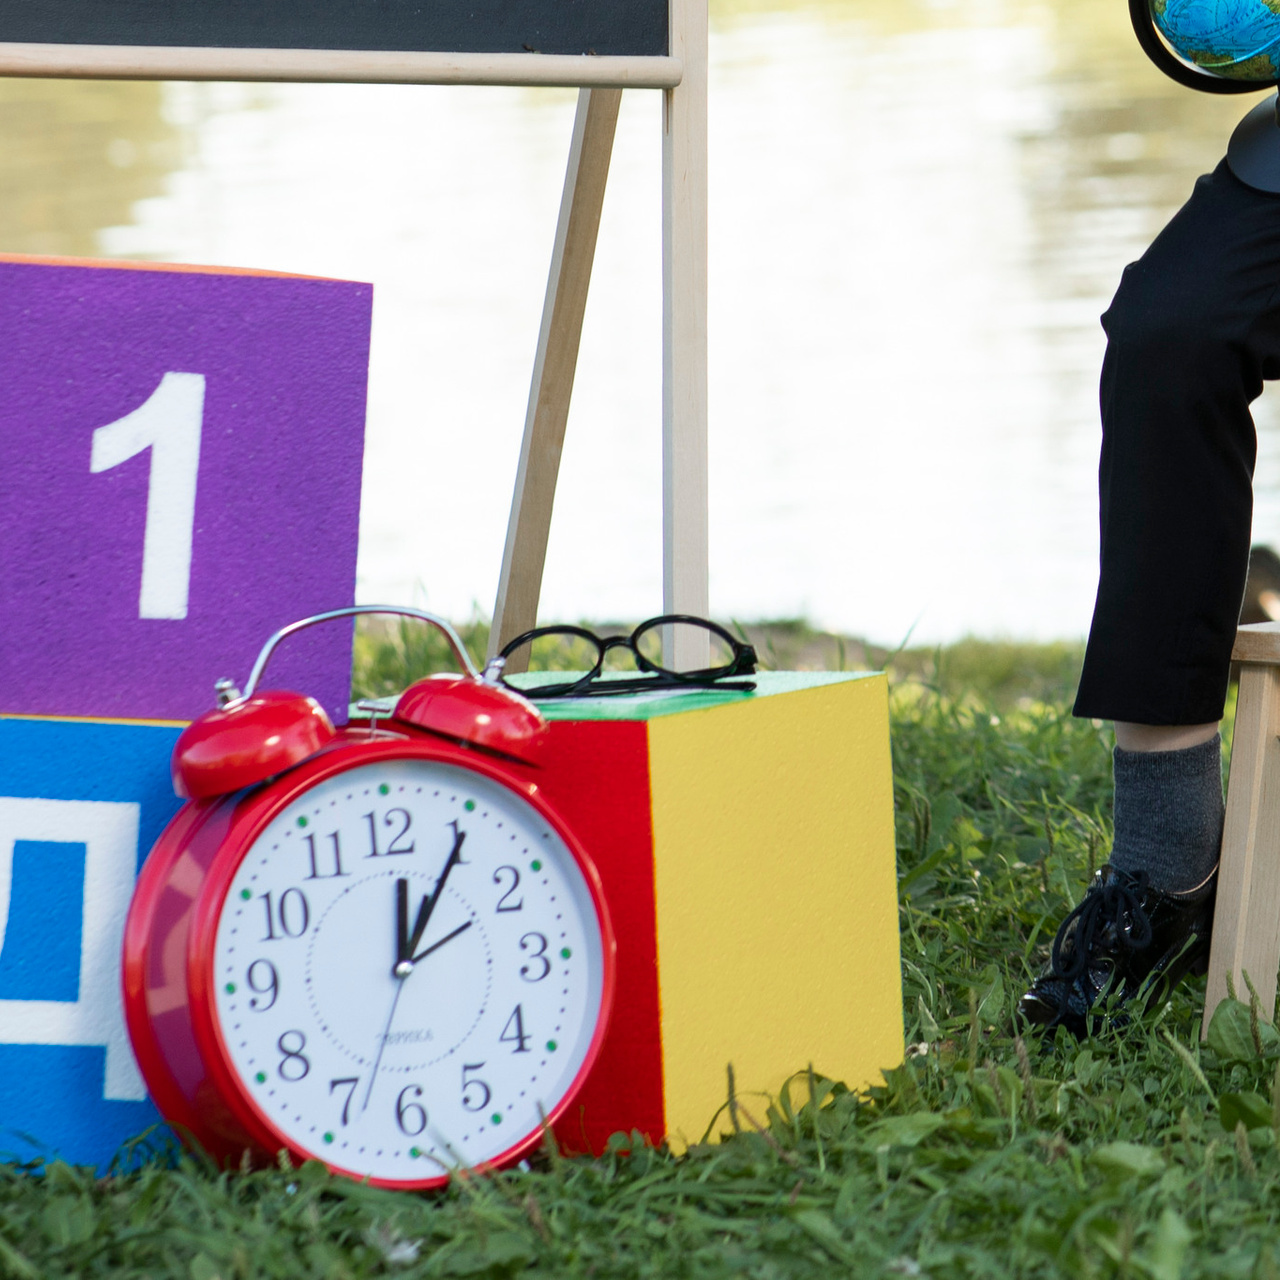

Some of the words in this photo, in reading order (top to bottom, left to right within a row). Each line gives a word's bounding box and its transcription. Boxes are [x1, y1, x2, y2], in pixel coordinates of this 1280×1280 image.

[90, 371, 205, 620] 1
[301, 829, 352, 881] 11
[361, 808, 415, 859] 12
[258, 887, 310, 942] 10
[493, 865, 524, 914] 2
[519, 931, 552, 983] 3
[246, 958, 280, 1013] 9
[499, 1003, 532, 1054] 4
[277, 1029, 311, 1082] 8
[329, 1077, 359, 1126] 7
[395, 1083, 428, 1136] 6
[461, 1061, 491, 1112] 5
